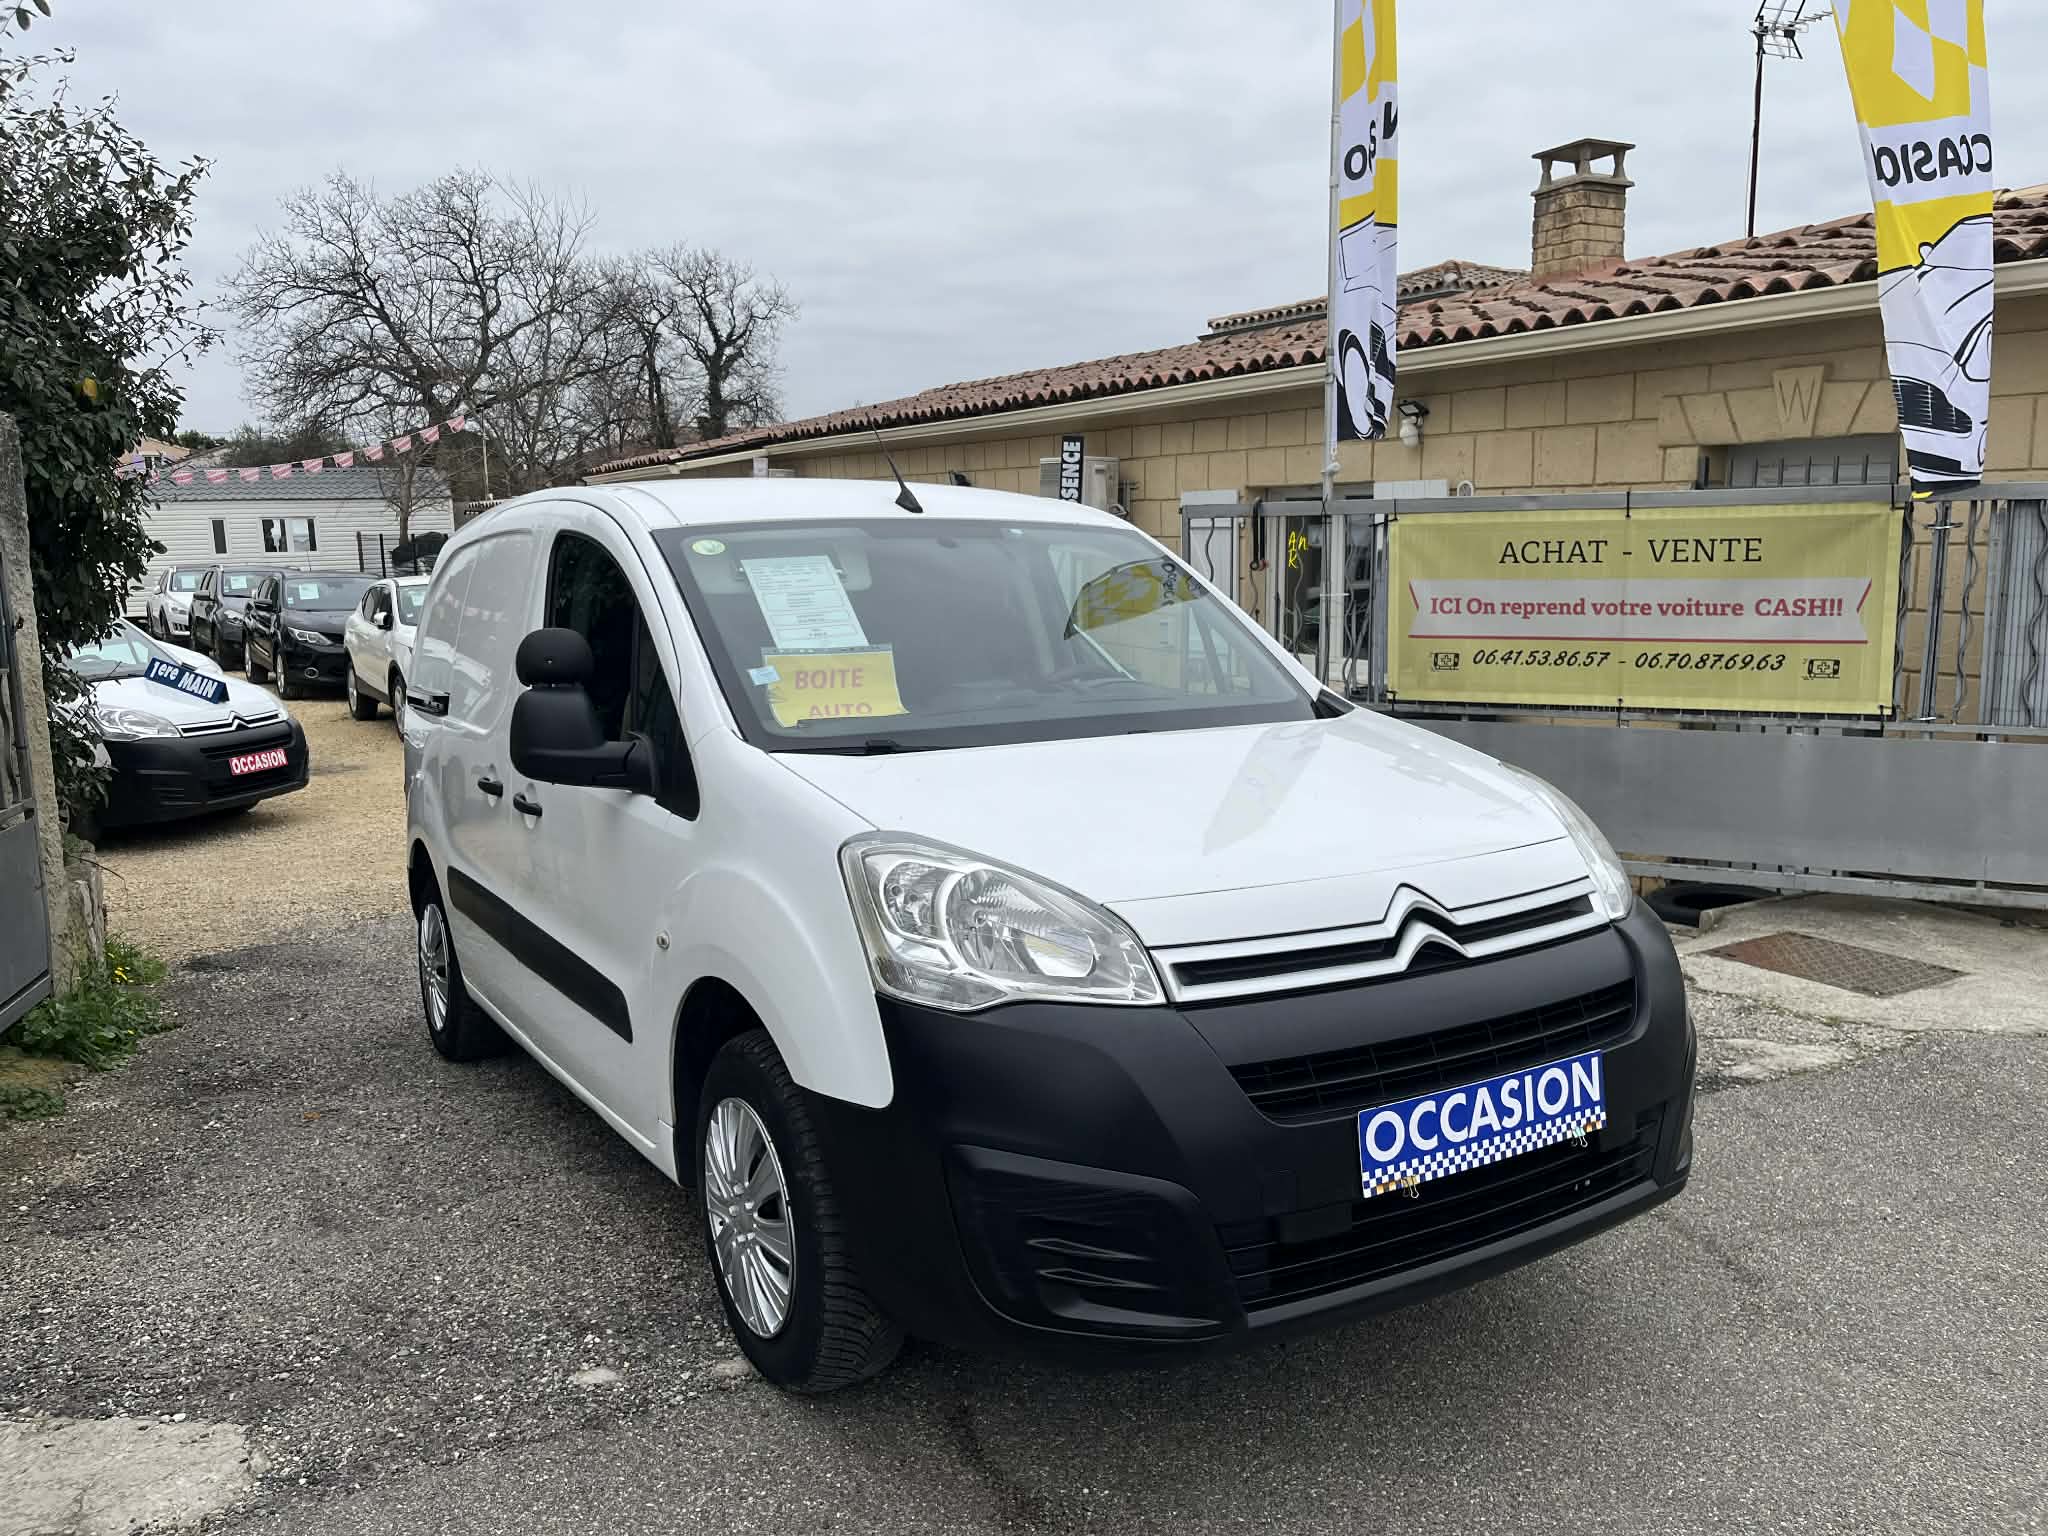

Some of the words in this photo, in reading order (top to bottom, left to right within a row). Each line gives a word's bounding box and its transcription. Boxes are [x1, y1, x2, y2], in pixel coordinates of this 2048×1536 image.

[1060, 441, 1081, 503] SENCE
[1498, 540, 1608, 564] ACHAT
[1647, 537, 1763, 563] VENTE
[1430, 597, 1463, 615] ICI
[1466, 598, 1498, 615] On
[1501, 598, 1586, 619] reprend
[1591, 601, 1652, 616] votre
[1657, 598, 1745, 616] voiture
[1754, 598, 1844, 617] CASH!!
[1472, 649, 1611, 668] 06.41.53.86.57
[1634, 652, 1787, 671] 06.70.87.69.63
[177, 671, 218, 699] MAIN
[794, 667, 865, 691] BOITE
[808, 702, 873, 718] AUTO
[230, 750, 287, 775] OCCASION
[1365, 1056, 1601, 1163] OCCASION
